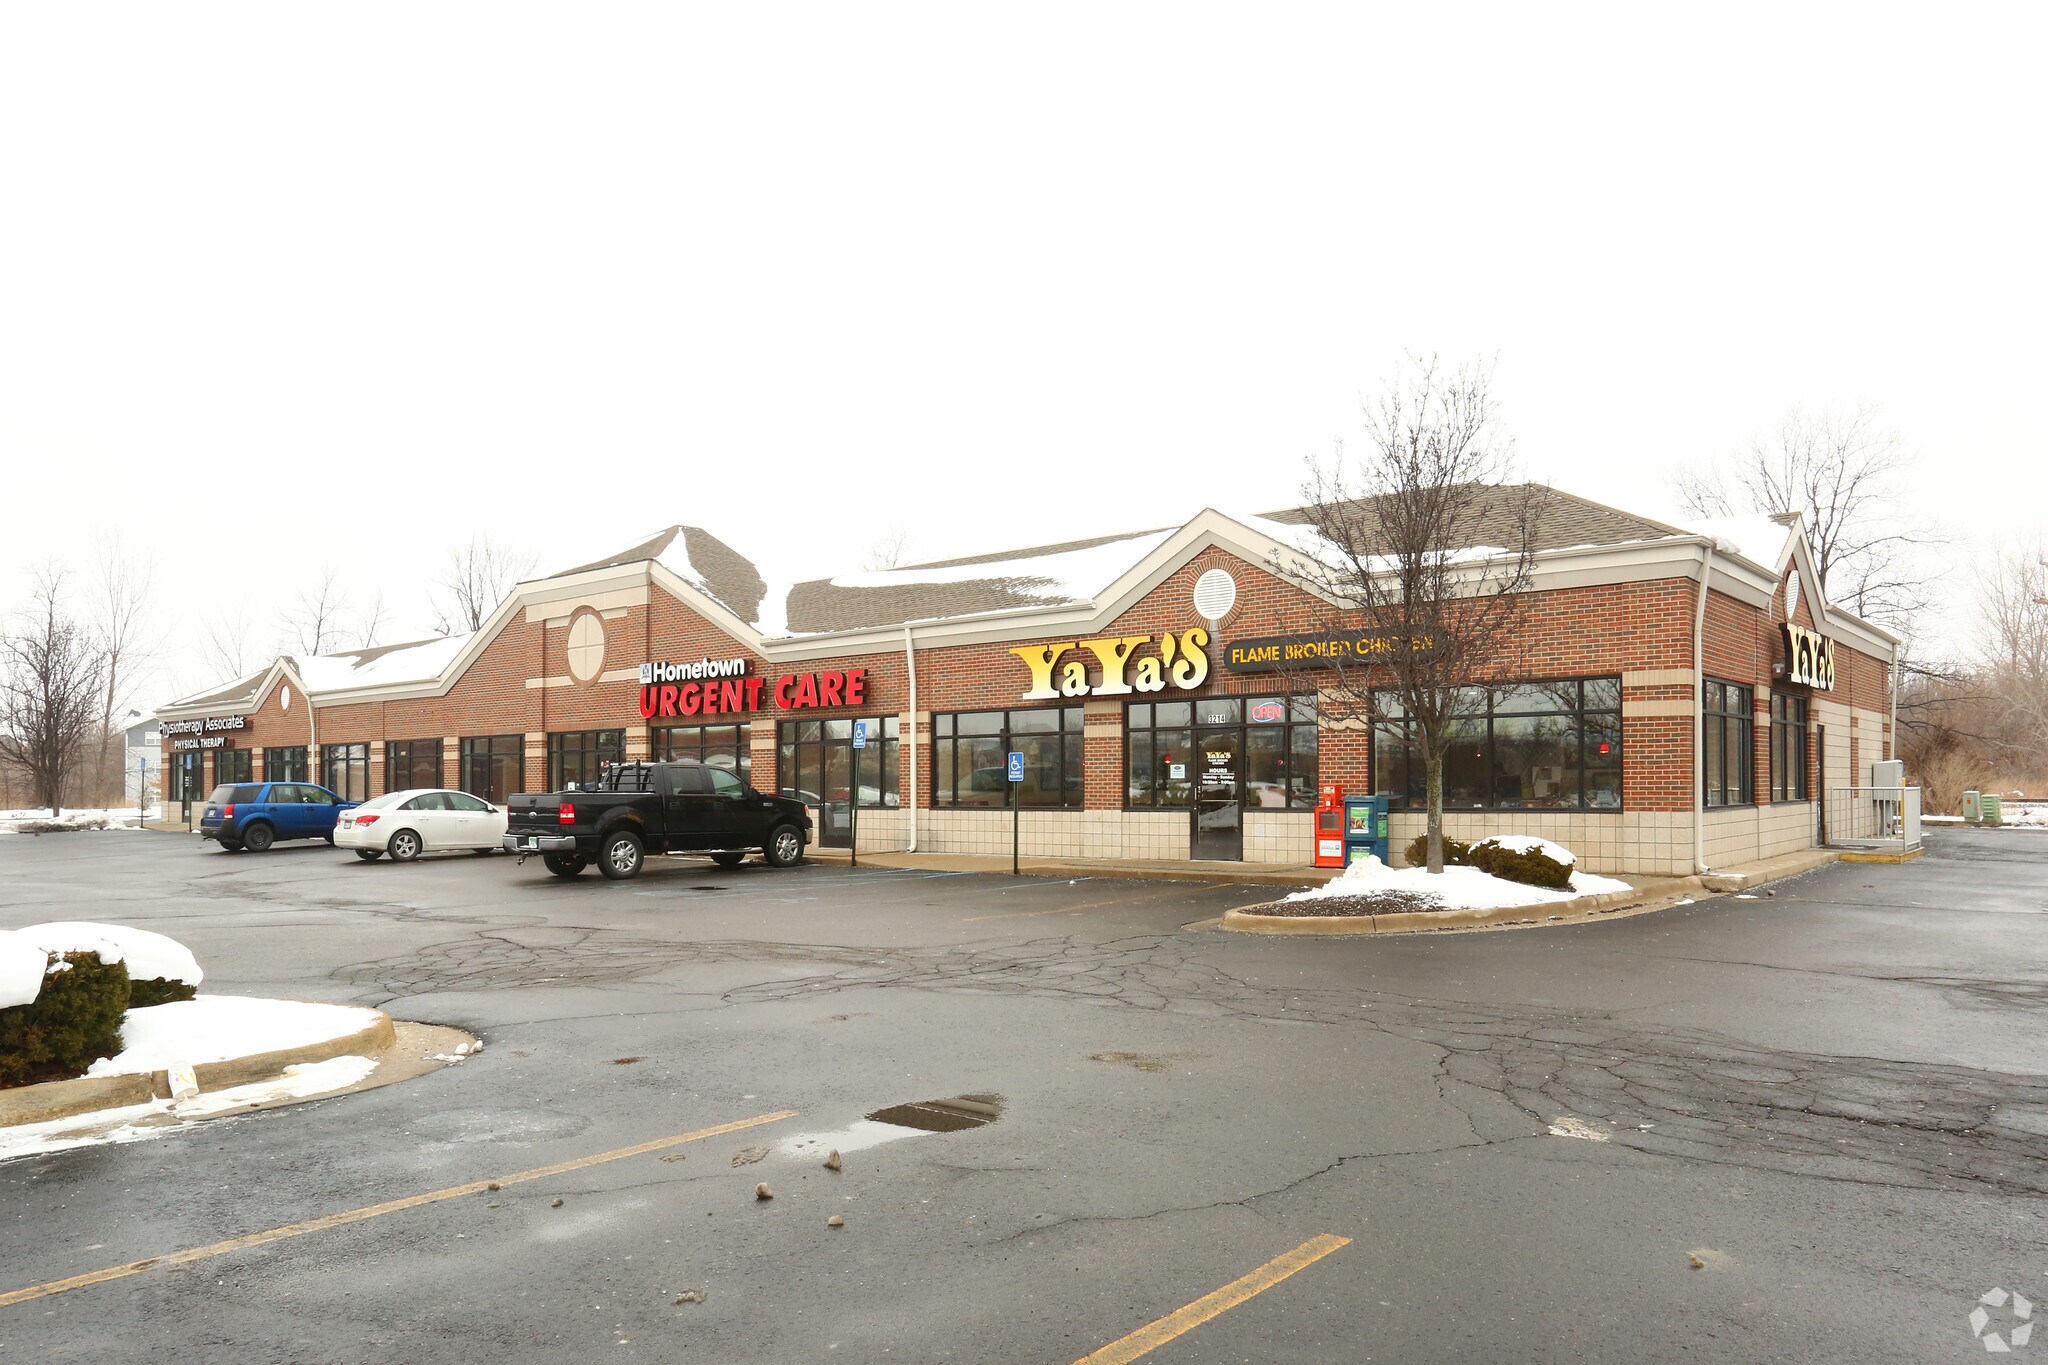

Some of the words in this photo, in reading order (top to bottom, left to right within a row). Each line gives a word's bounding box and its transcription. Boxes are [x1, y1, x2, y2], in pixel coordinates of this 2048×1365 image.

[1232, 646, 1280, 664] FLAME
[1285, 640, 1350, 660] BROILED
[653, 658, 745, 682] Hometown
[639, 678, 763, 719] URGENT
[774, 668, 866, 709] CARE
[1208, 714, 1226, 723] 3214
[1252, 706, 1282, 719] OPEN
[158, 719, 204, 738] Physiotherapy
[205, 715, 244, 731] Associates
[174, 739, 199, 750] PHYSICAL
[200, 737, 225, 748] THERAPY
